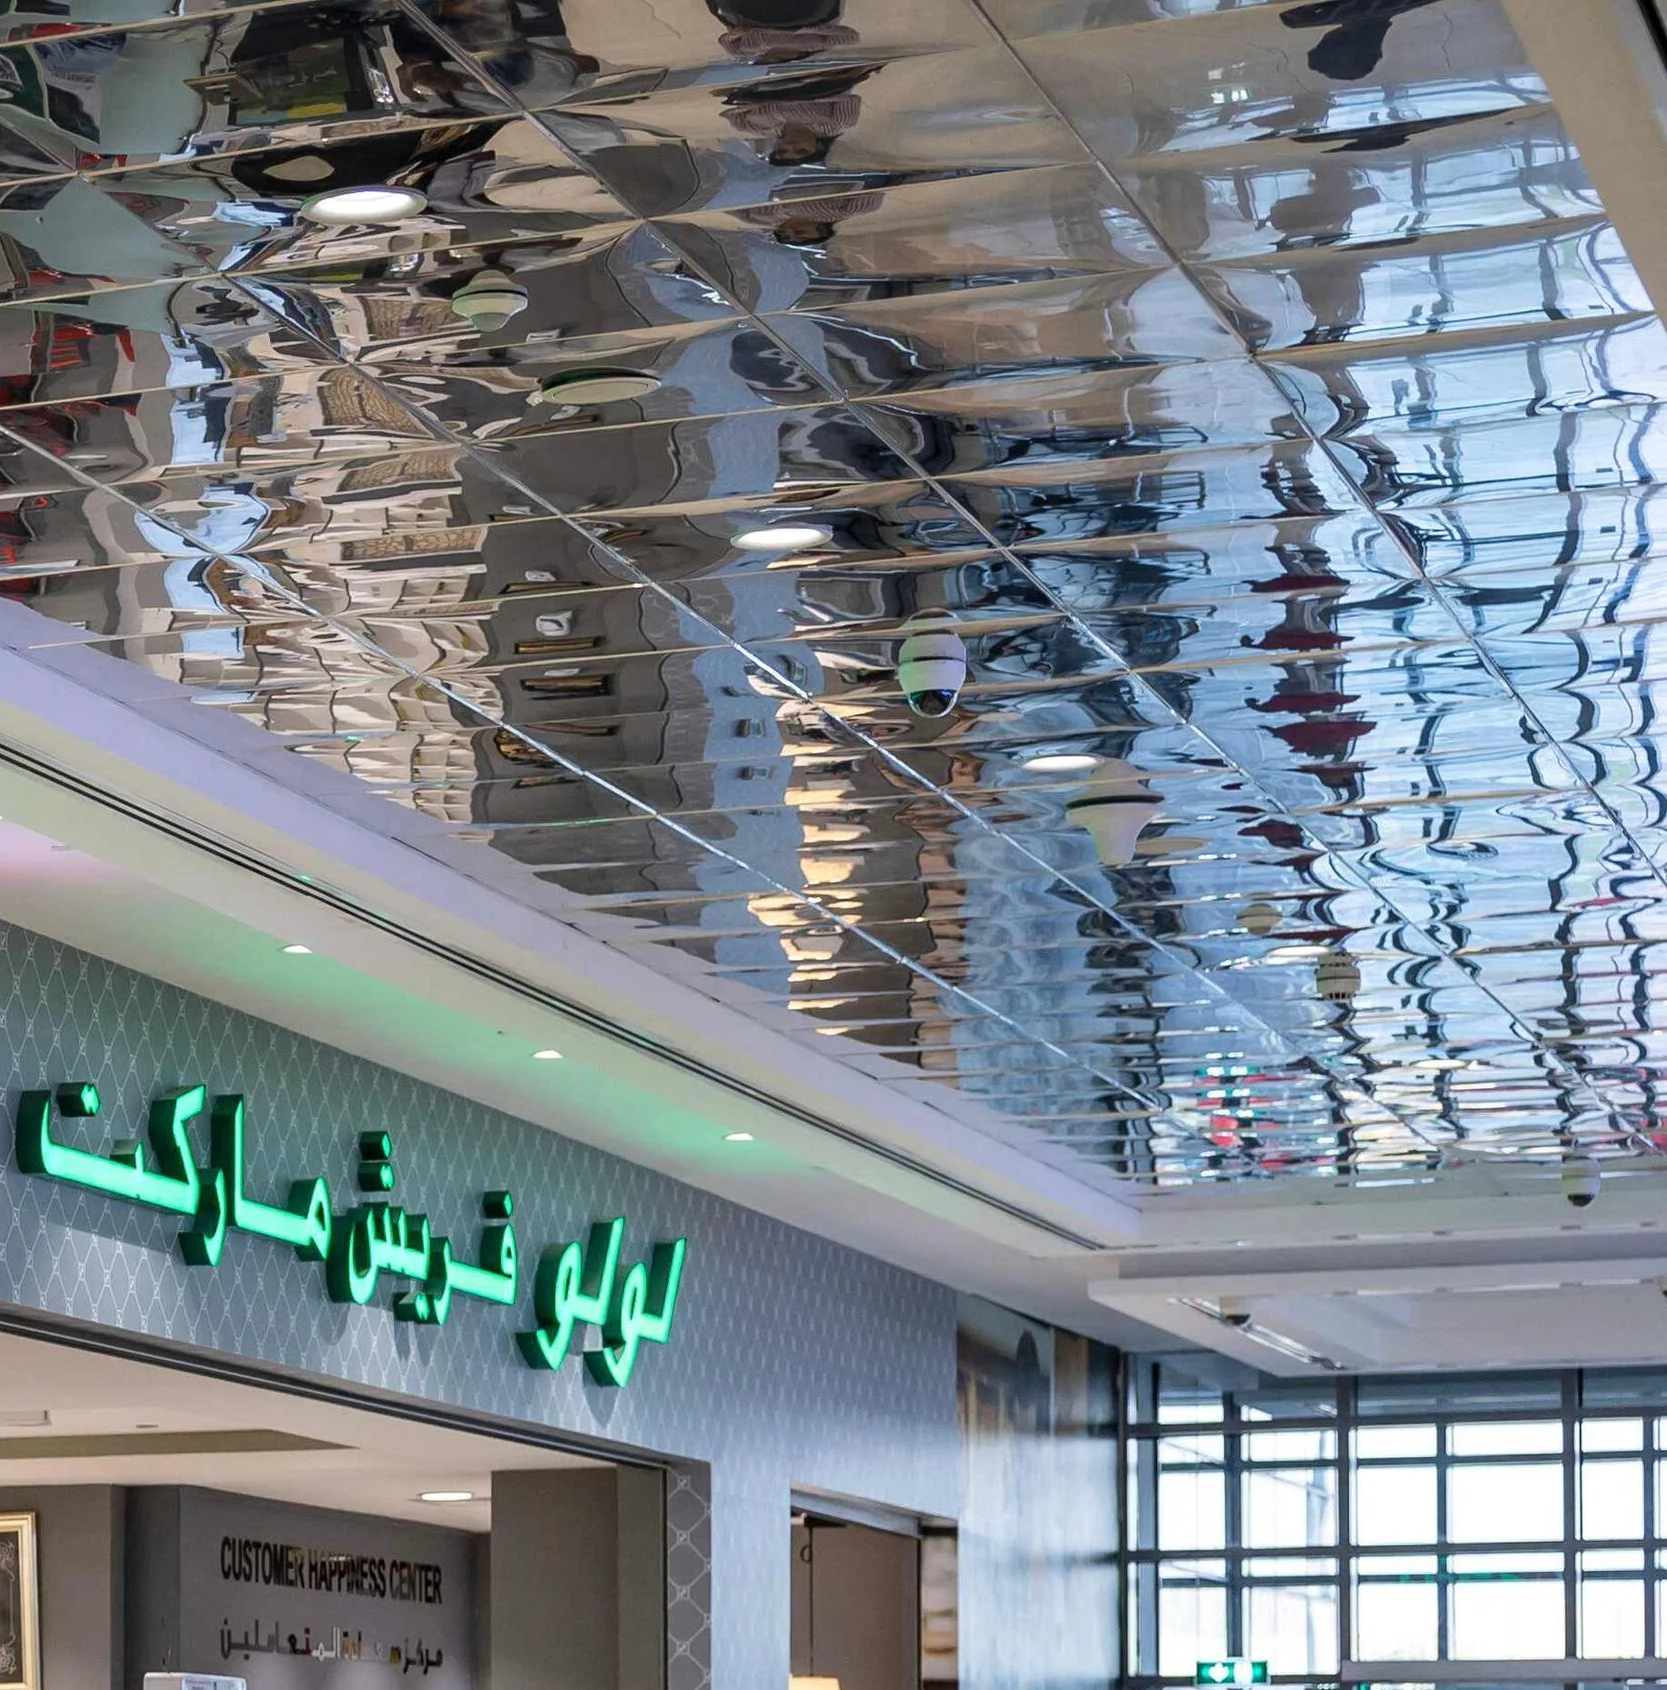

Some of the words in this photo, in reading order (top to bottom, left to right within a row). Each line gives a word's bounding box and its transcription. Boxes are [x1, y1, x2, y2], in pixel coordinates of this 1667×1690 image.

[15, 1082, 332, 1266] ماركت
[327, 1129, 517, 1325] فريش
[516, 1215, 687, 1387] لولو
[220, 1536, 305, 1589] CUSTOMER
[308, 1549, 386, 1598] HAPPINESS
[389, 1559, 443, 1604] CENTER
[403, 1636, 443, 1675] مركز
